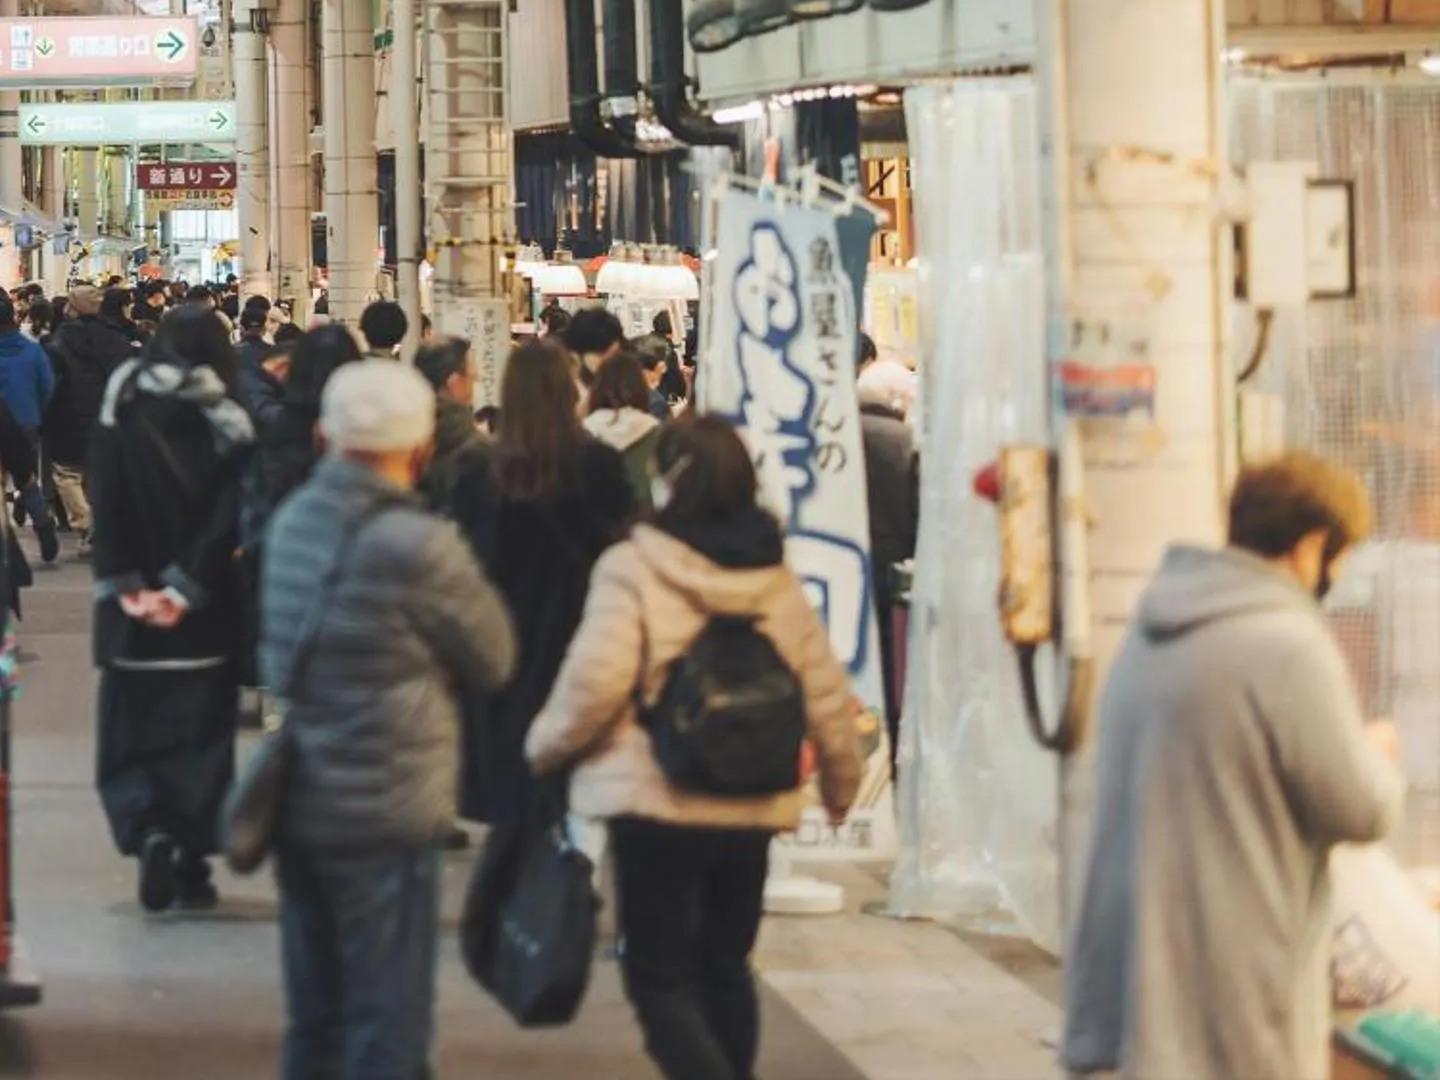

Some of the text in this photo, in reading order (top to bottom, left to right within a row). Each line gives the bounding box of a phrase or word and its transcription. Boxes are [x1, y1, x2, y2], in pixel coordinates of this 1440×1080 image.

[808, 236, 848, 474] 魚屋さんの
